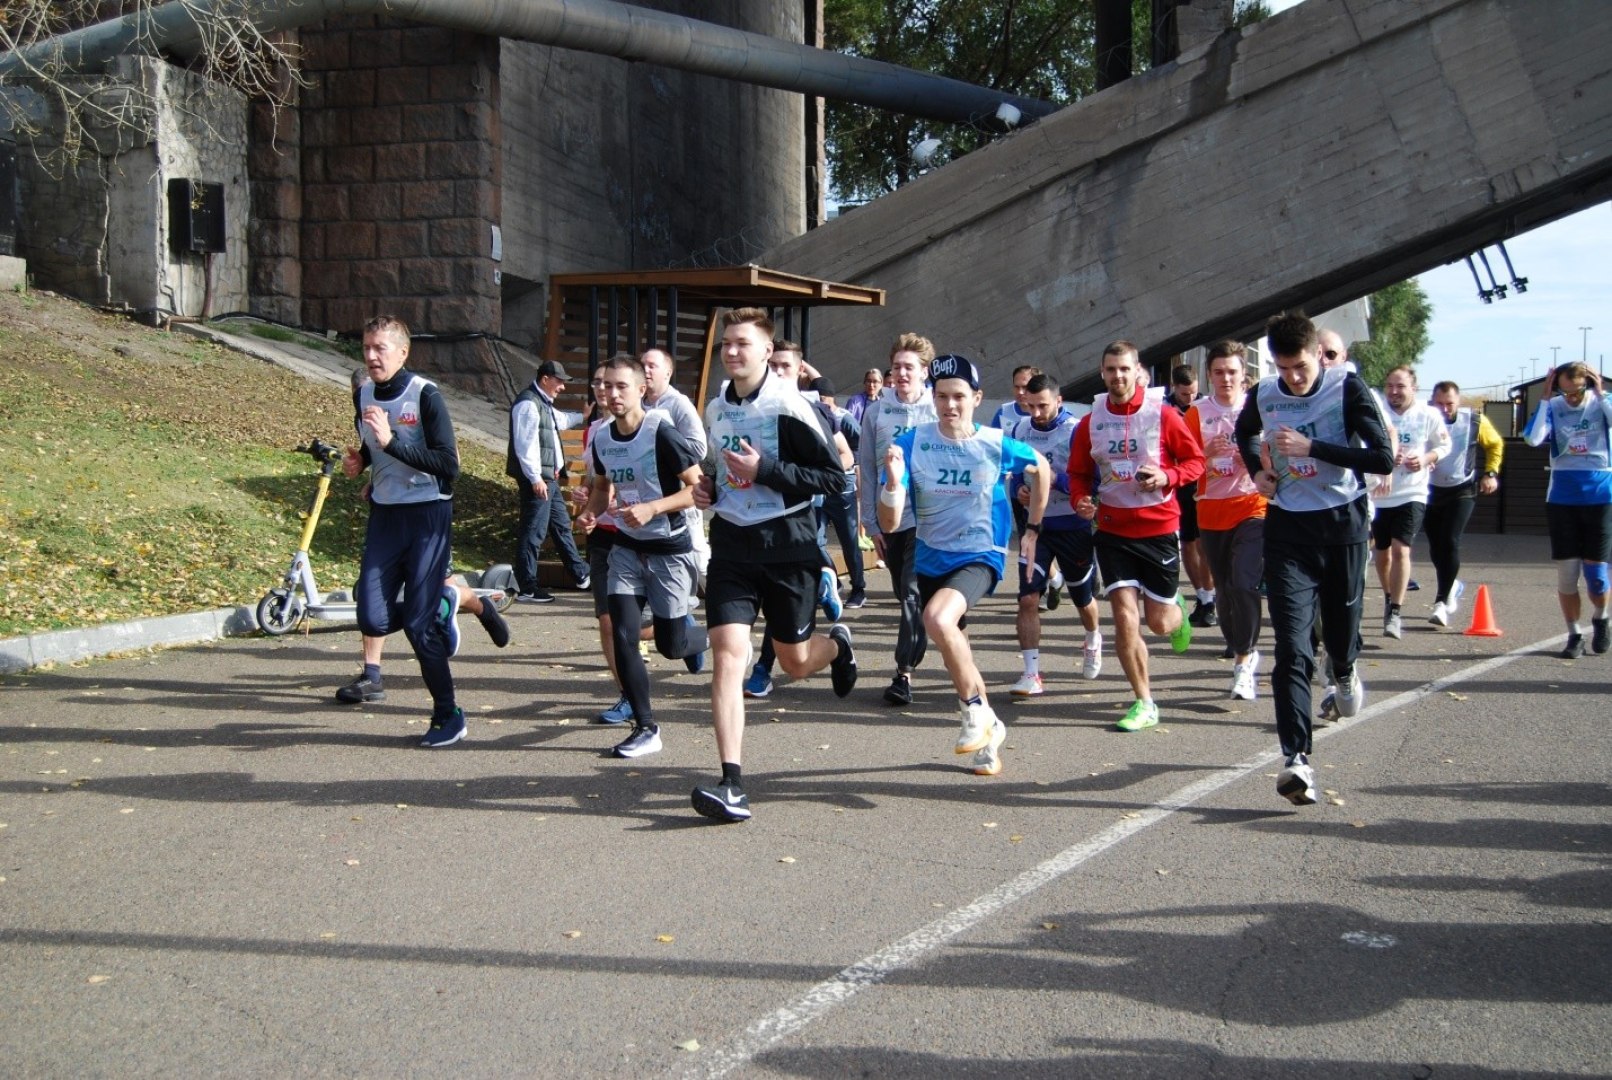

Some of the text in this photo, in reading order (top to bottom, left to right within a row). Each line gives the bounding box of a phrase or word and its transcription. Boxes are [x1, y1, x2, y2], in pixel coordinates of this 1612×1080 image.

[1108, 438, 1138, 454] 263
[610, 467, 635, 483] 278
[936, 468, 972, 486] 214
